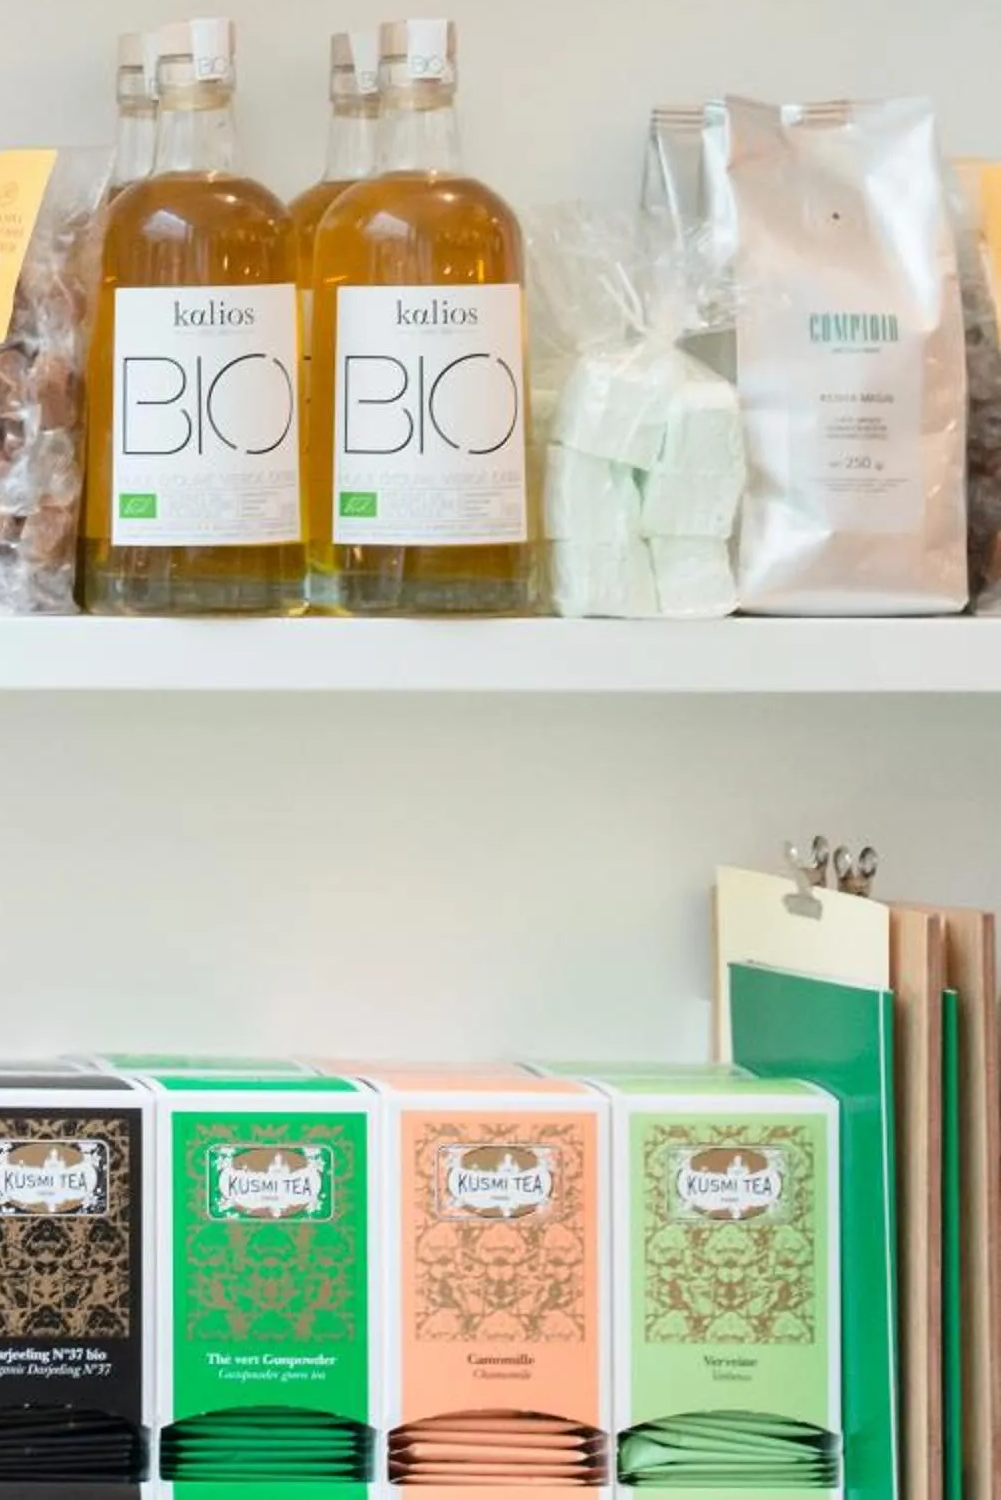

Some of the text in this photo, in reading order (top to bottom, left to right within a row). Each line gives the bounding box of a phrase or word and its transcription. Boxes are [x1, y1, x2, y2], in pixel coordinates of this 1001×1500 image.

[173, 300, 256, 328] kalios
[395, 298, 479, 326] kalios
[121, 352, 295, 456] BIO
[344, 352, 518, 456] BIO
[3, 1170, 88, 1192] KUSMI TEA
[227, 1174, 312, 1197] KUSMI TEA
[457, 1173, 544, 1195] KUSMI TEA
[686, 1174, 772, 1196] KUSMI TEA
[52, 1347, 84, 1360] N°37
[86, 1347, 108, 1360] bio
[234, 1354, 259, 1365] vert
[261, 1352, 337, 1369] Gunpowder
[27, 1363, 81, 1379] Darjeeling
[83, 1363, 113, 1376] N°37
